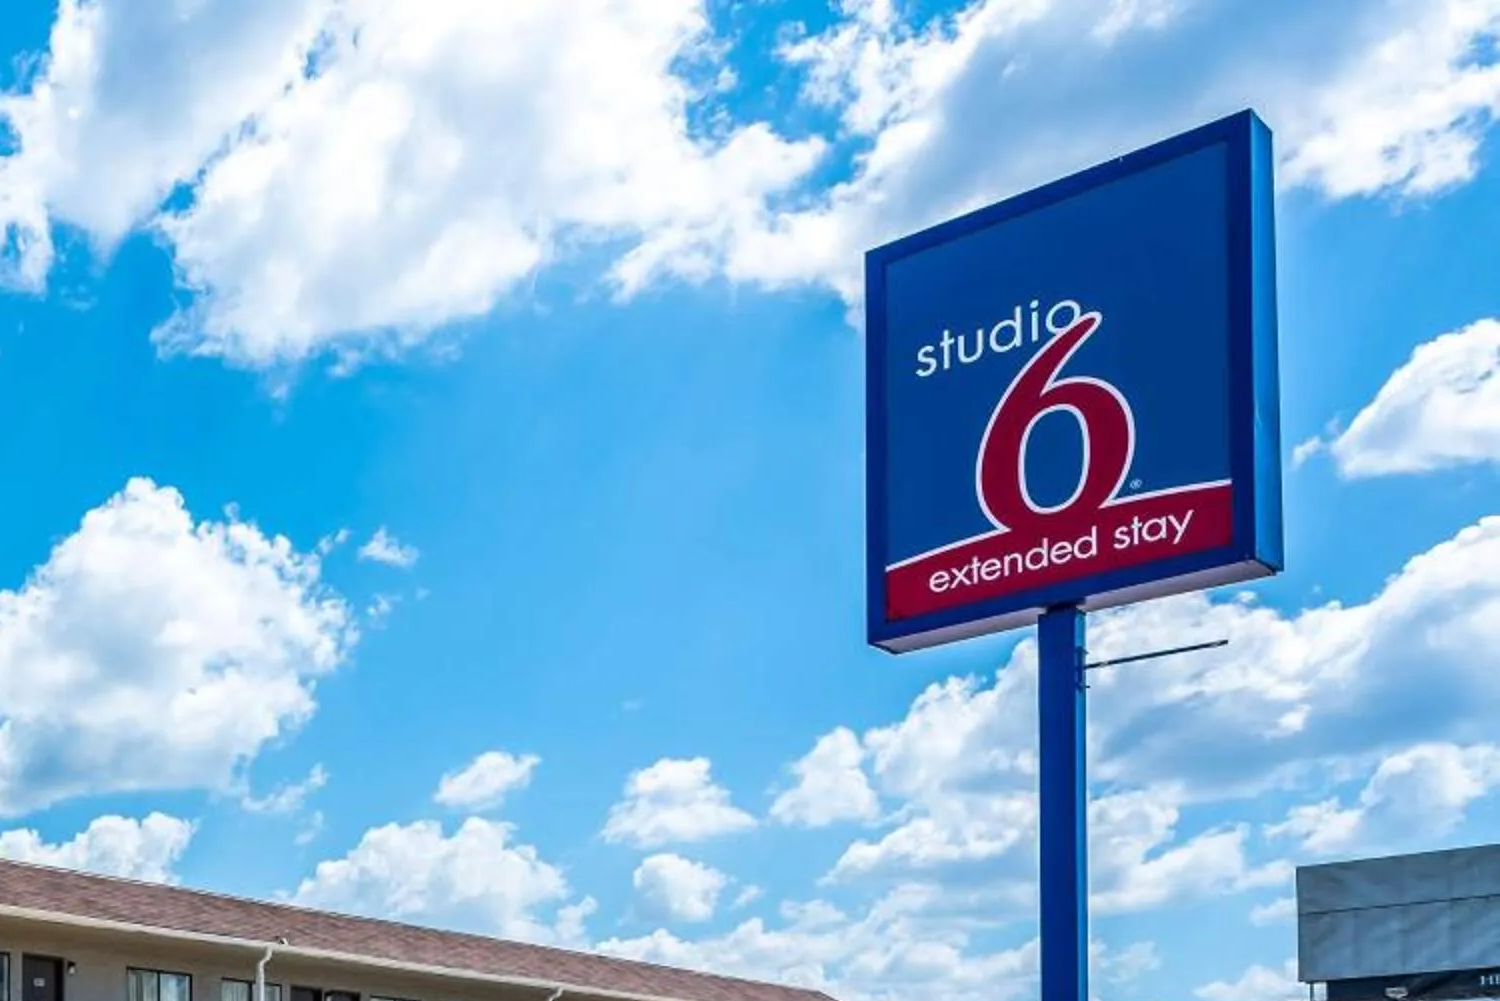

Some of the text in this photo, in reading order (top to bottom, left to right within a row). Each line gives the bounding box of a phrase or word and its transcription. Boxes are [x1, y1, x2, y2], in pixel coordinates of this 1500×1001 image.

[916, 300, 1081, 377] studio
[976, 311, 1135, 532] 6
[929, 509, 1195, 593] extended stay
